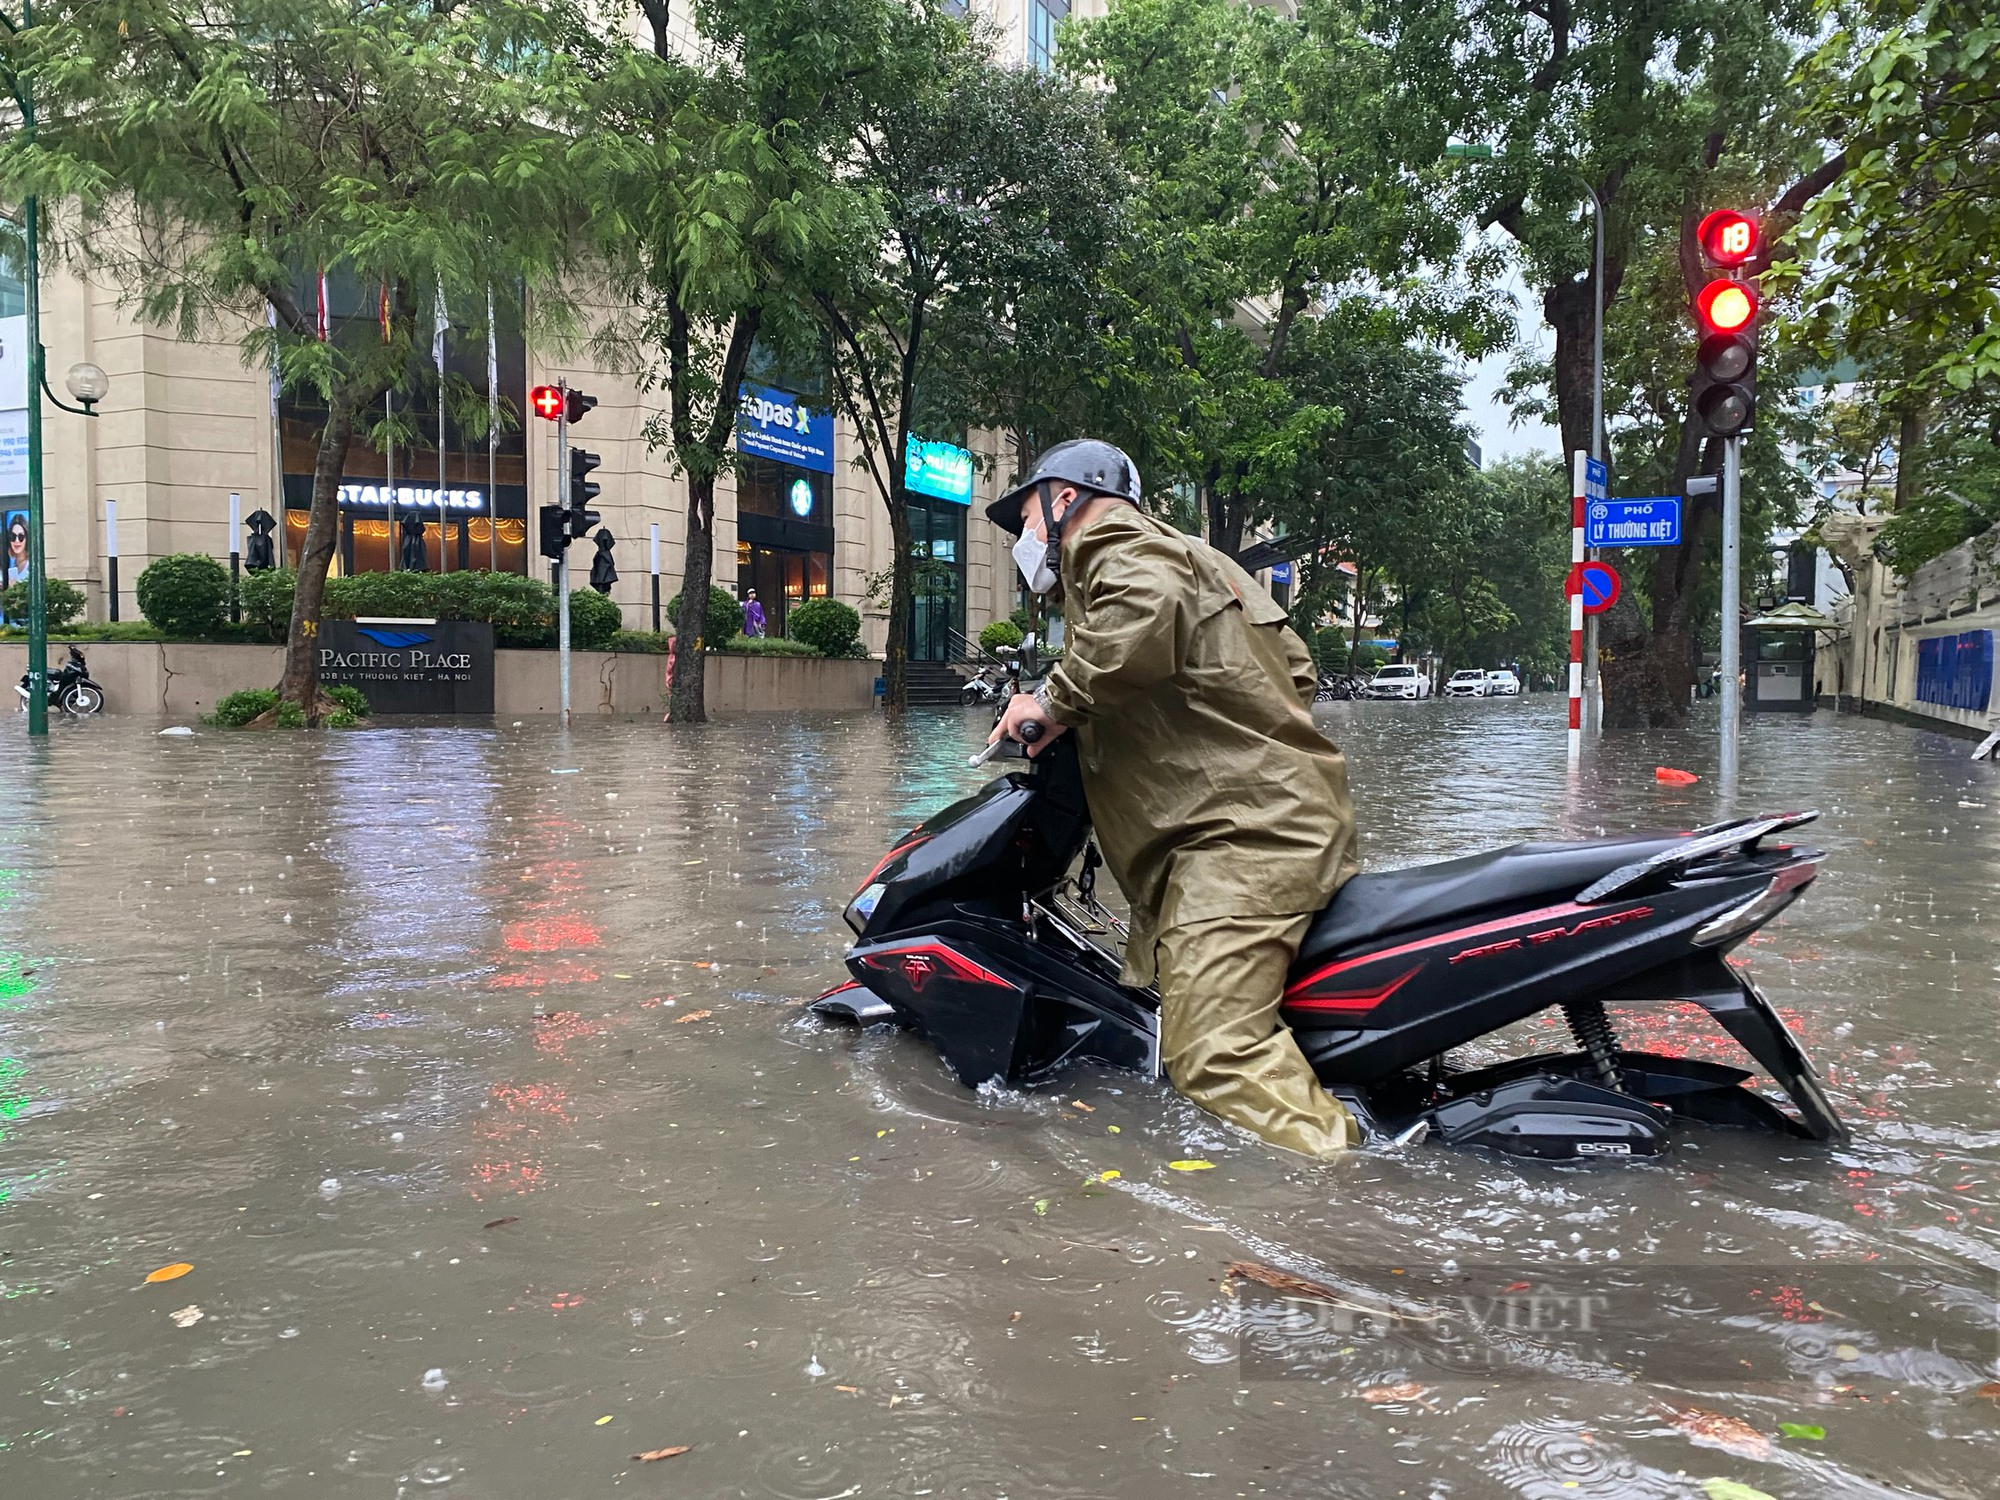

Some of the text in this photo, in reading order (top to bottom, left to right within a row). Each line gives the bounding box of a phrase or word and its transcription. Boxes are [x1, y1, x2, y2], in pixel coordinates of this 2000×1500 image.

[1723, 222, 1750, 253] 18
[1624, 502, 1654, 515] PHỐ
[1594, 518, 1672, 540] LÝ THƯỜNG KIỆT
[319, 649, 471, 669] PACIFIC PLACE
[404, 673, 425, 681] KIET
